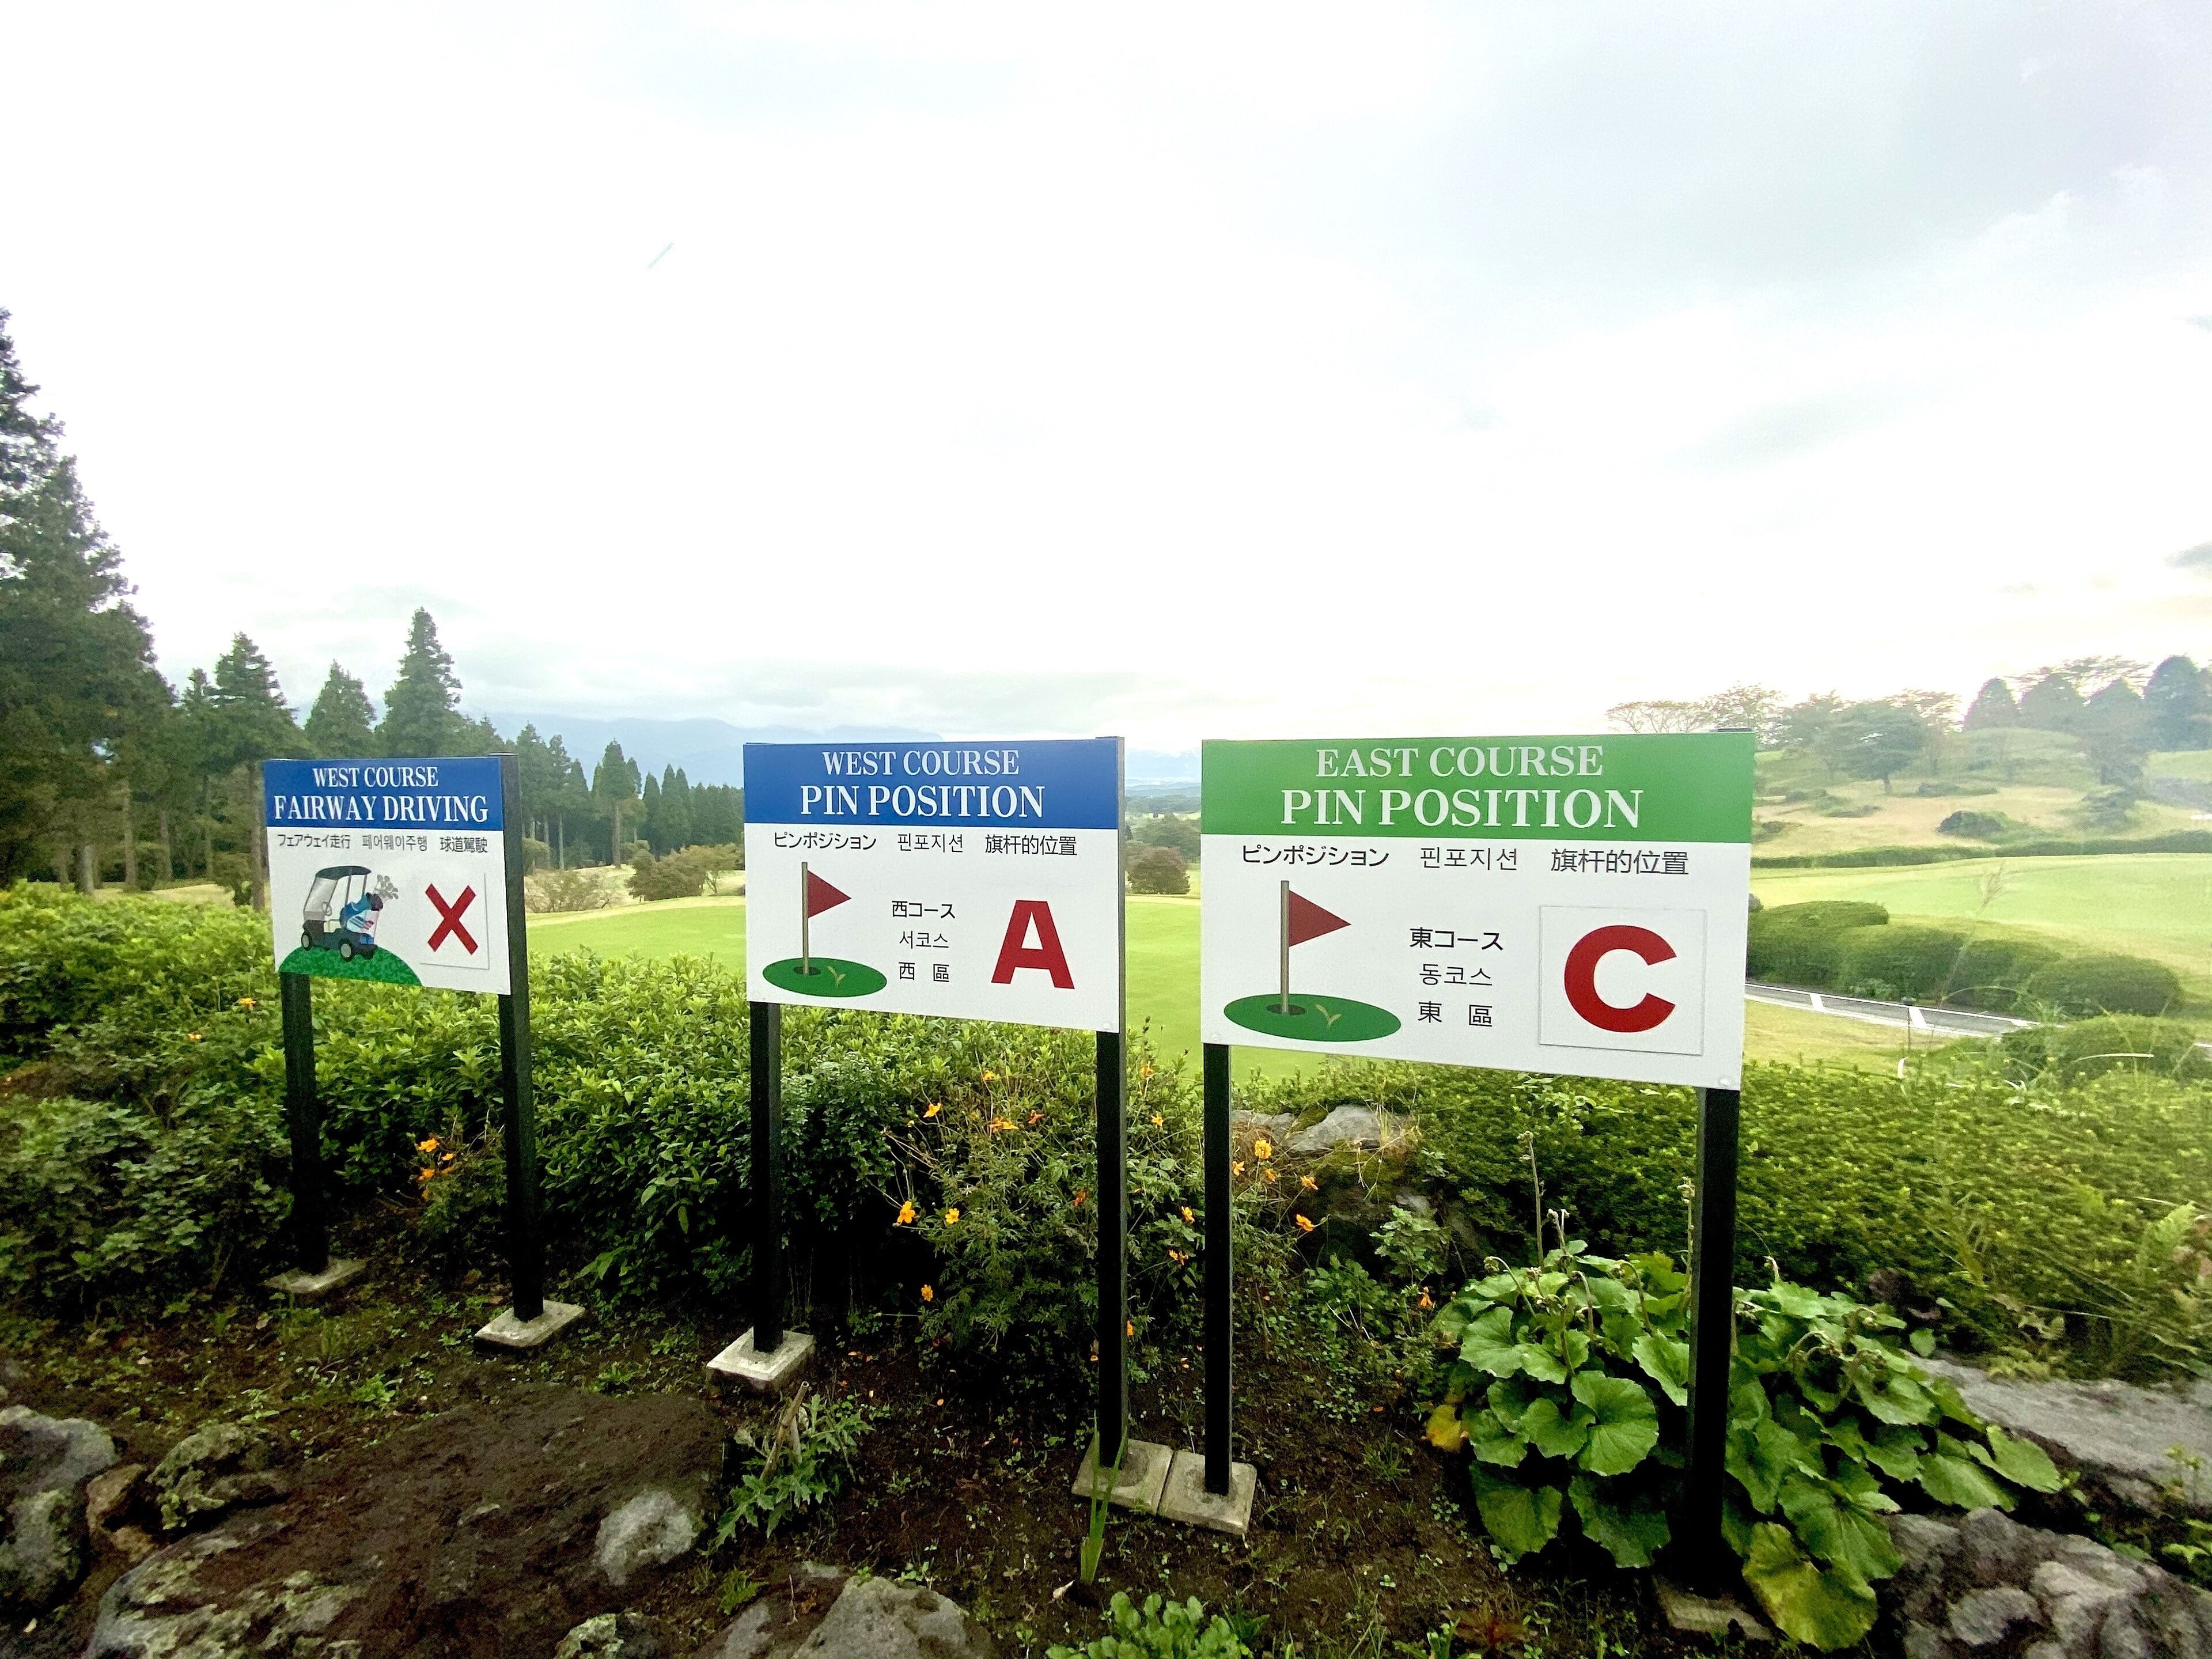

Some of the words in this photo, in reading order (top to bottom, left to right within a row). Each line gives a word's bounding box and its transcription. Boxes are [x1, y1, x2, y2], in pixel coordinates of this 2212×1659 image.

[822, 752, 896, 775] WEST
[904, 750, 1018, 775] COURSE
[1316, 748, 1418, 777] EAST
[1430, 746, 1603, 777] COURSE
[313, 767, 359, 787] WEST
[365, 767, 438, 787] COURSE
[274, 796, 377, 820] FAIRWAY
[383, 796, 488, 822] DRIVING
[801, 786, 859, 815] PIN
[868, 786, 1045, 817] POSITION
[1281, 790, 1366, 824] PIN
[1379, 789, 1643, 828] POSITION
[278, 835, 350, 849] フェアウェイ走行
[362, 835, 427, 851] 페어웨이주행
[440, 836, 487, 853] 球道駕駛
[775, 832, 876, 850] ピンポジション
[898, 834, 963, 853] 핀포지션
[985, 834, 1077, 855] 旗杆的位置
[1244, 844, 1389, 866] ピンポジション
[1421, 847, 1516, 870] 핀포지션
[1551, 849, 1688, 874] 旗杆的位置
[892, 901, 955, 918] 西コース
[900, 931, 949, 949] 서코스
[991, 900, 1075, 989] A
[1410, 927, 1503, 950] 東コース
[1419, 964, 1492, 986] 동코스
[1565, 926, 1677, 1032] C
